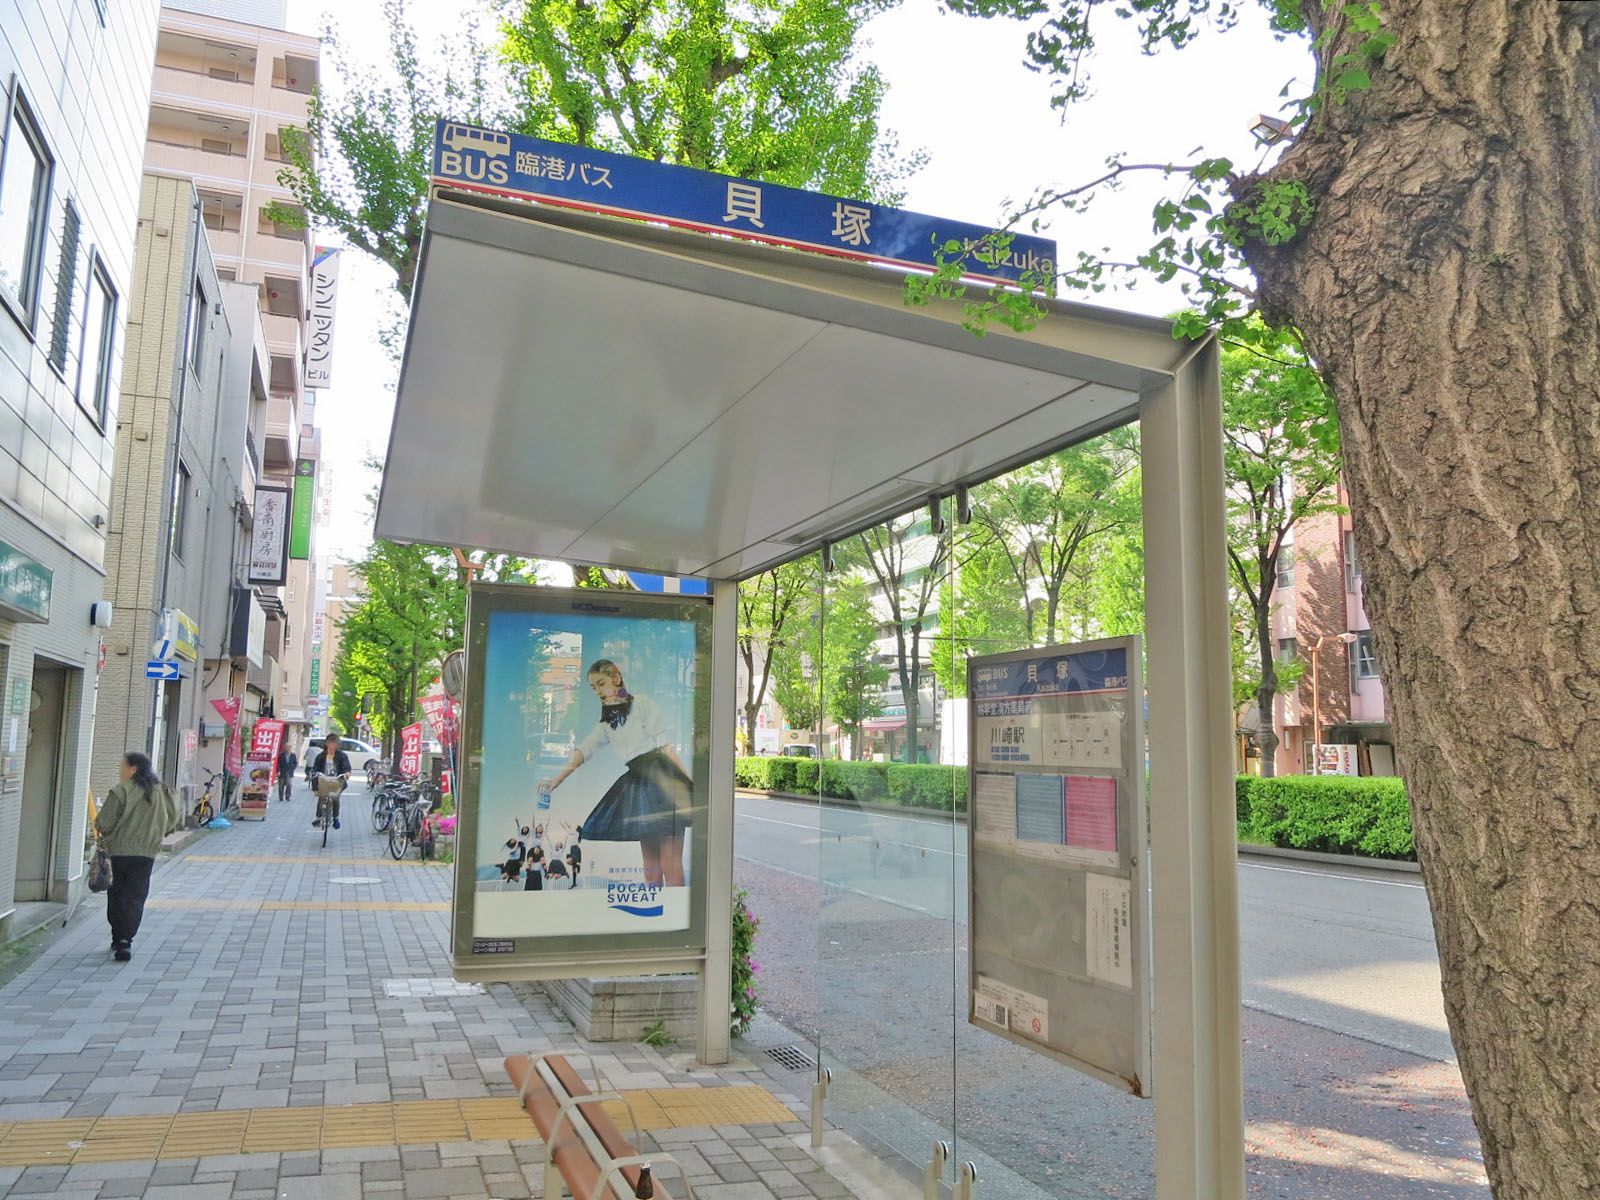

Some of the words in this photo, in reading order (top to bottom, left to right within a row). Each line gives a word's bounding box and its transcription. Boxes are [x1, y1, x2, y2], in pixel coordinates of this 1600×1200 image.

[440, 151, 509, 185] BUS
[514, 150, 614, 189] 臨港バス
[722, 181, 872, 246] 貝塚
[307, 369, 329, 380] ビル
[992, 667, 1009, 680] BUS
[991, 727, 1025, 744] 川崎駅
[607, 883, 664, 893] POCARI
[607, 893, 657, 903] SWEAT
